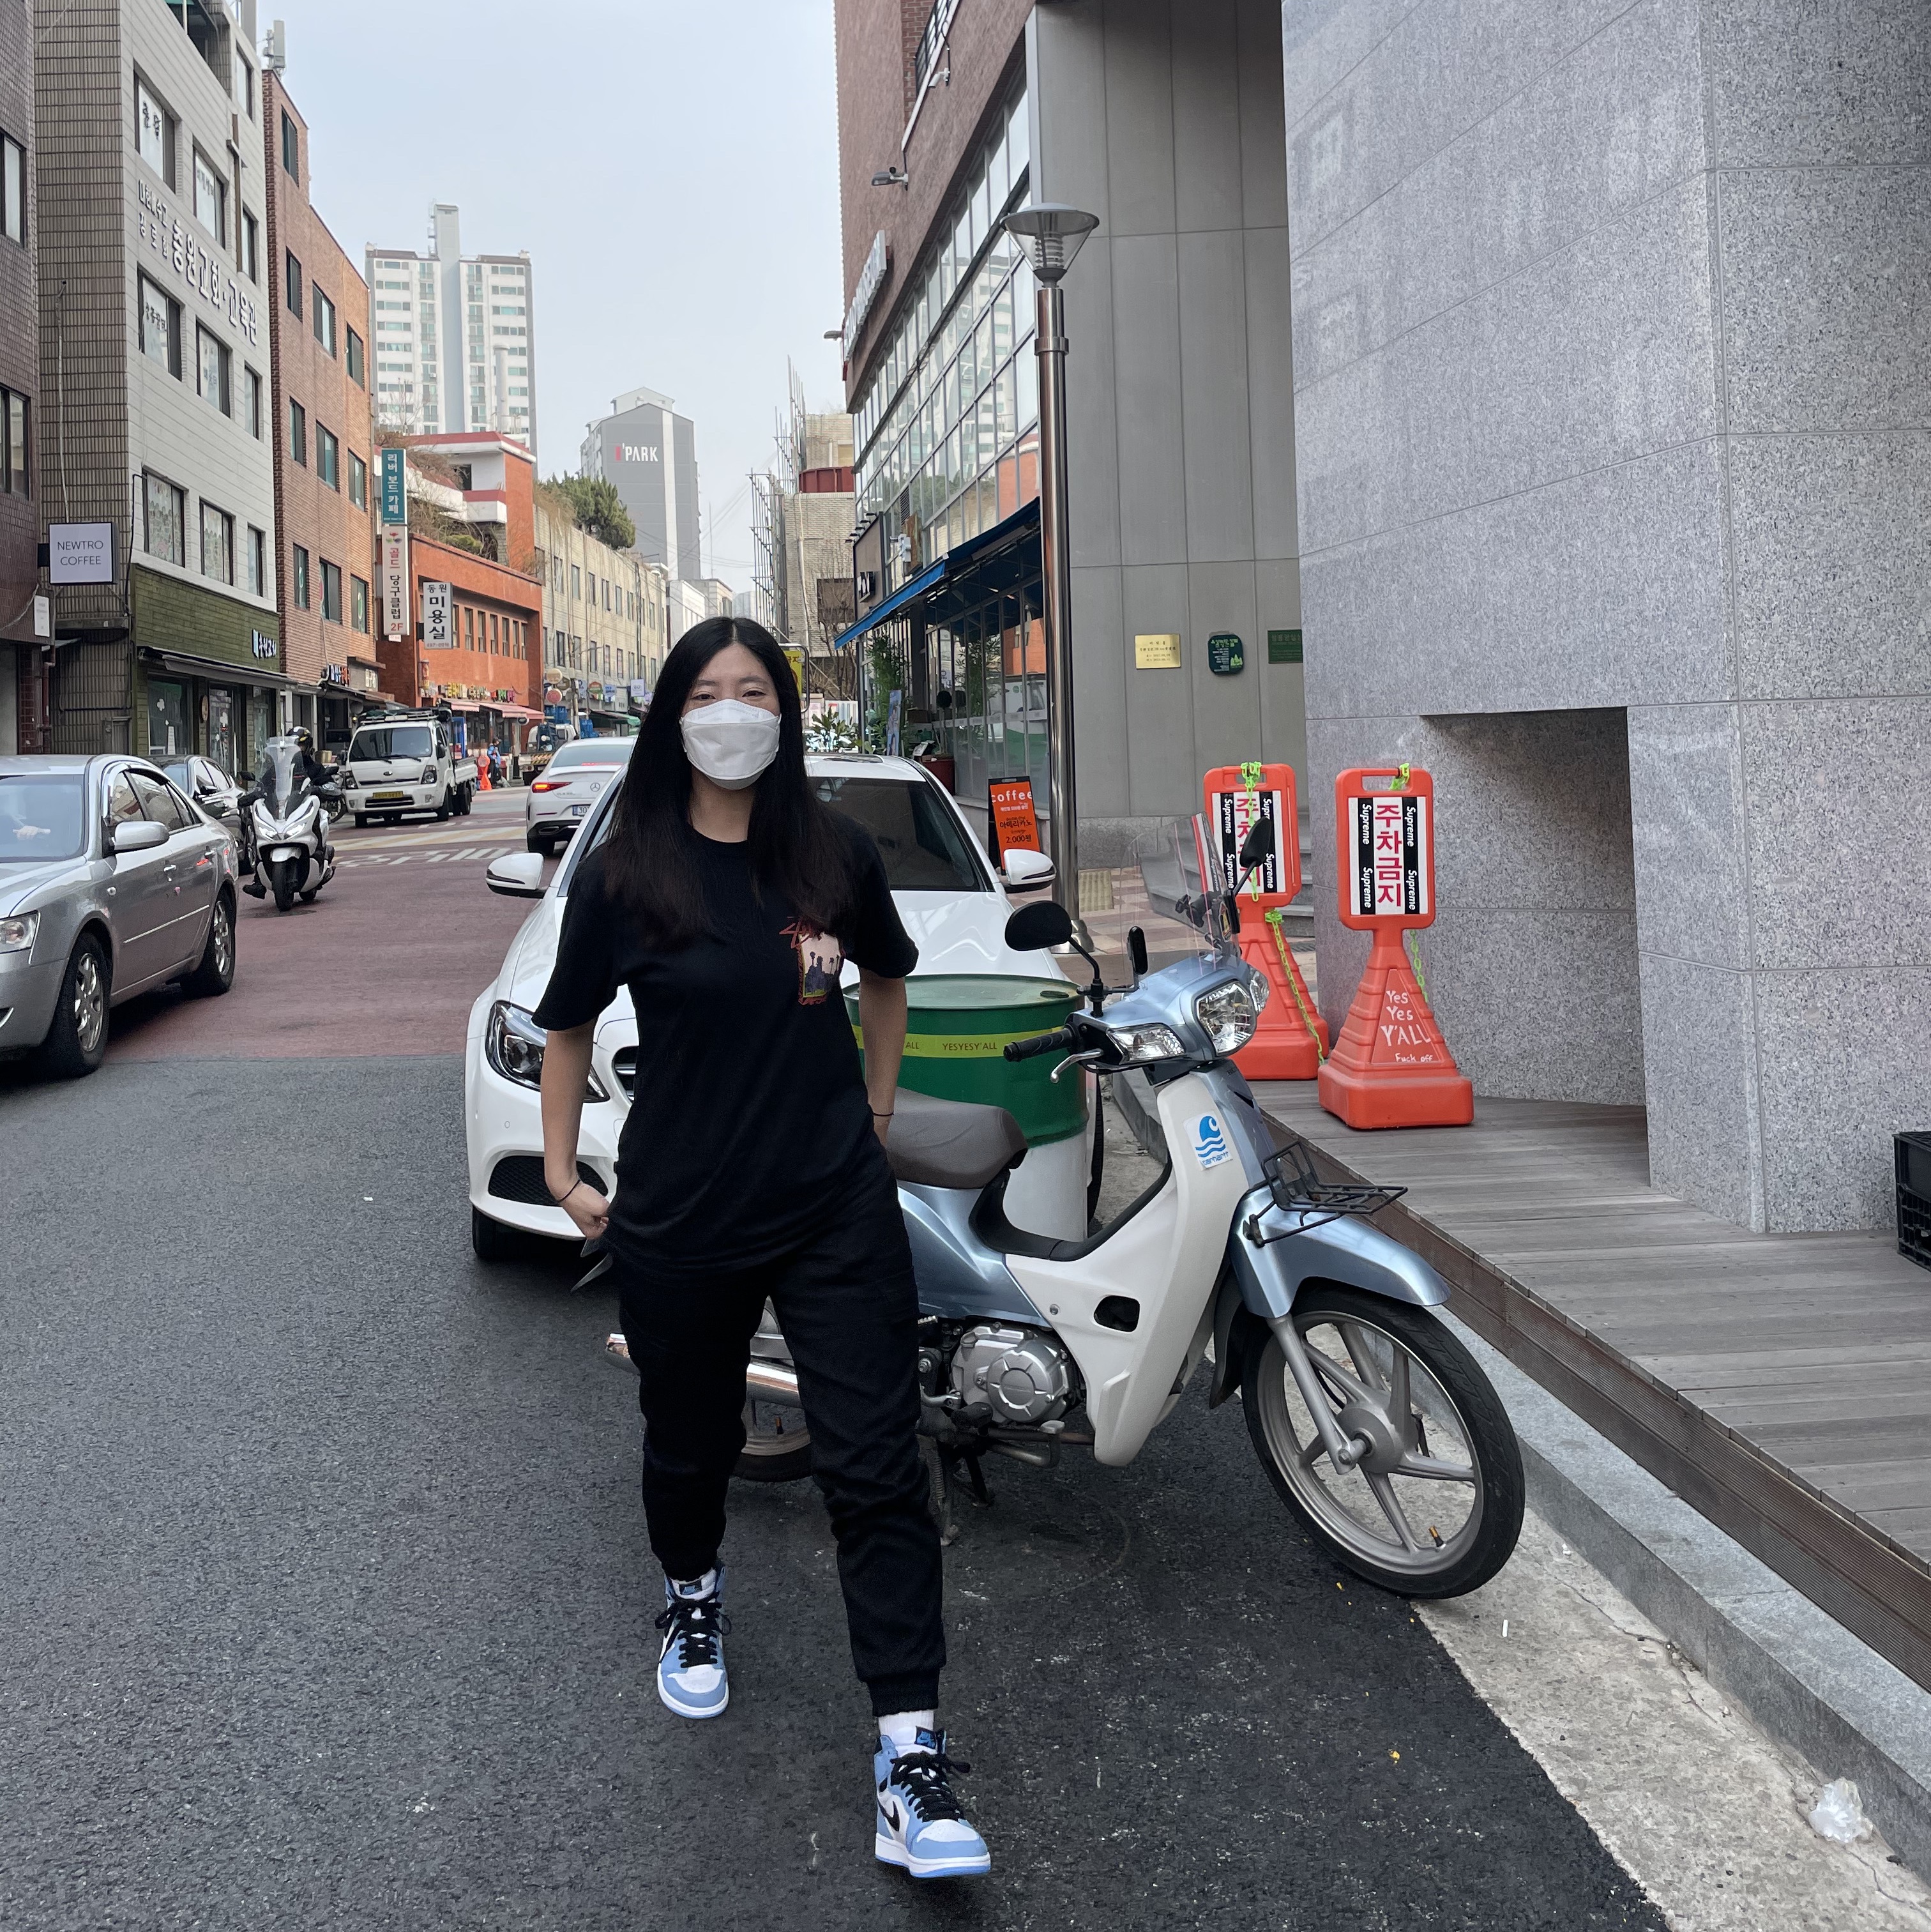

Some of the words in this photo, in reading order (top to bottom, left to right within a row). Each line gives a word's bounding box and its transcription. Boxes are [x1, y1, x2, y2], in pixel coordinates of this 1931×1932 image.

[387, 453, 398, 473] 리버
[387, 475, 398, 493] 보드
[388, 495, 399, 514] 카페
[57, 540, 103, 551] NEWTRO
[60, 556, 102, 566] COFFEE
[390, 547, 400, 569] 골드
[390, 575, 401, 620] 당구클럽
[427, 584, 447, 593] 동원
[390, 623, 404, 631] 2F
[428, 596, 447, 640] 미용실
[999, 820, 1033, 829] 아메리카노
[1222, 798, 1233, 834] Supreme
[1360, 803, 1372, 845] Supreme
[1405, 806, 1416, 847] Supreme
[1375, 805, 1402, 907] 주차금지
[1225, 853, 1235, 888] Supreme
[1264, 853, 1275, 888] Supreme
[1361, 867, 1373, 908] Supreme
[1406, 869, 1417, 911] Supreme
[1386, 990, 1409, 1004] Yes
[1386, 1005, 1413, 1021] Yes
[1381, 1024, 1431, 1046] Y'ALL
[1395, 1053, 1416, 1063] Fuck
[1420, 1054, 1433, 1063] off
